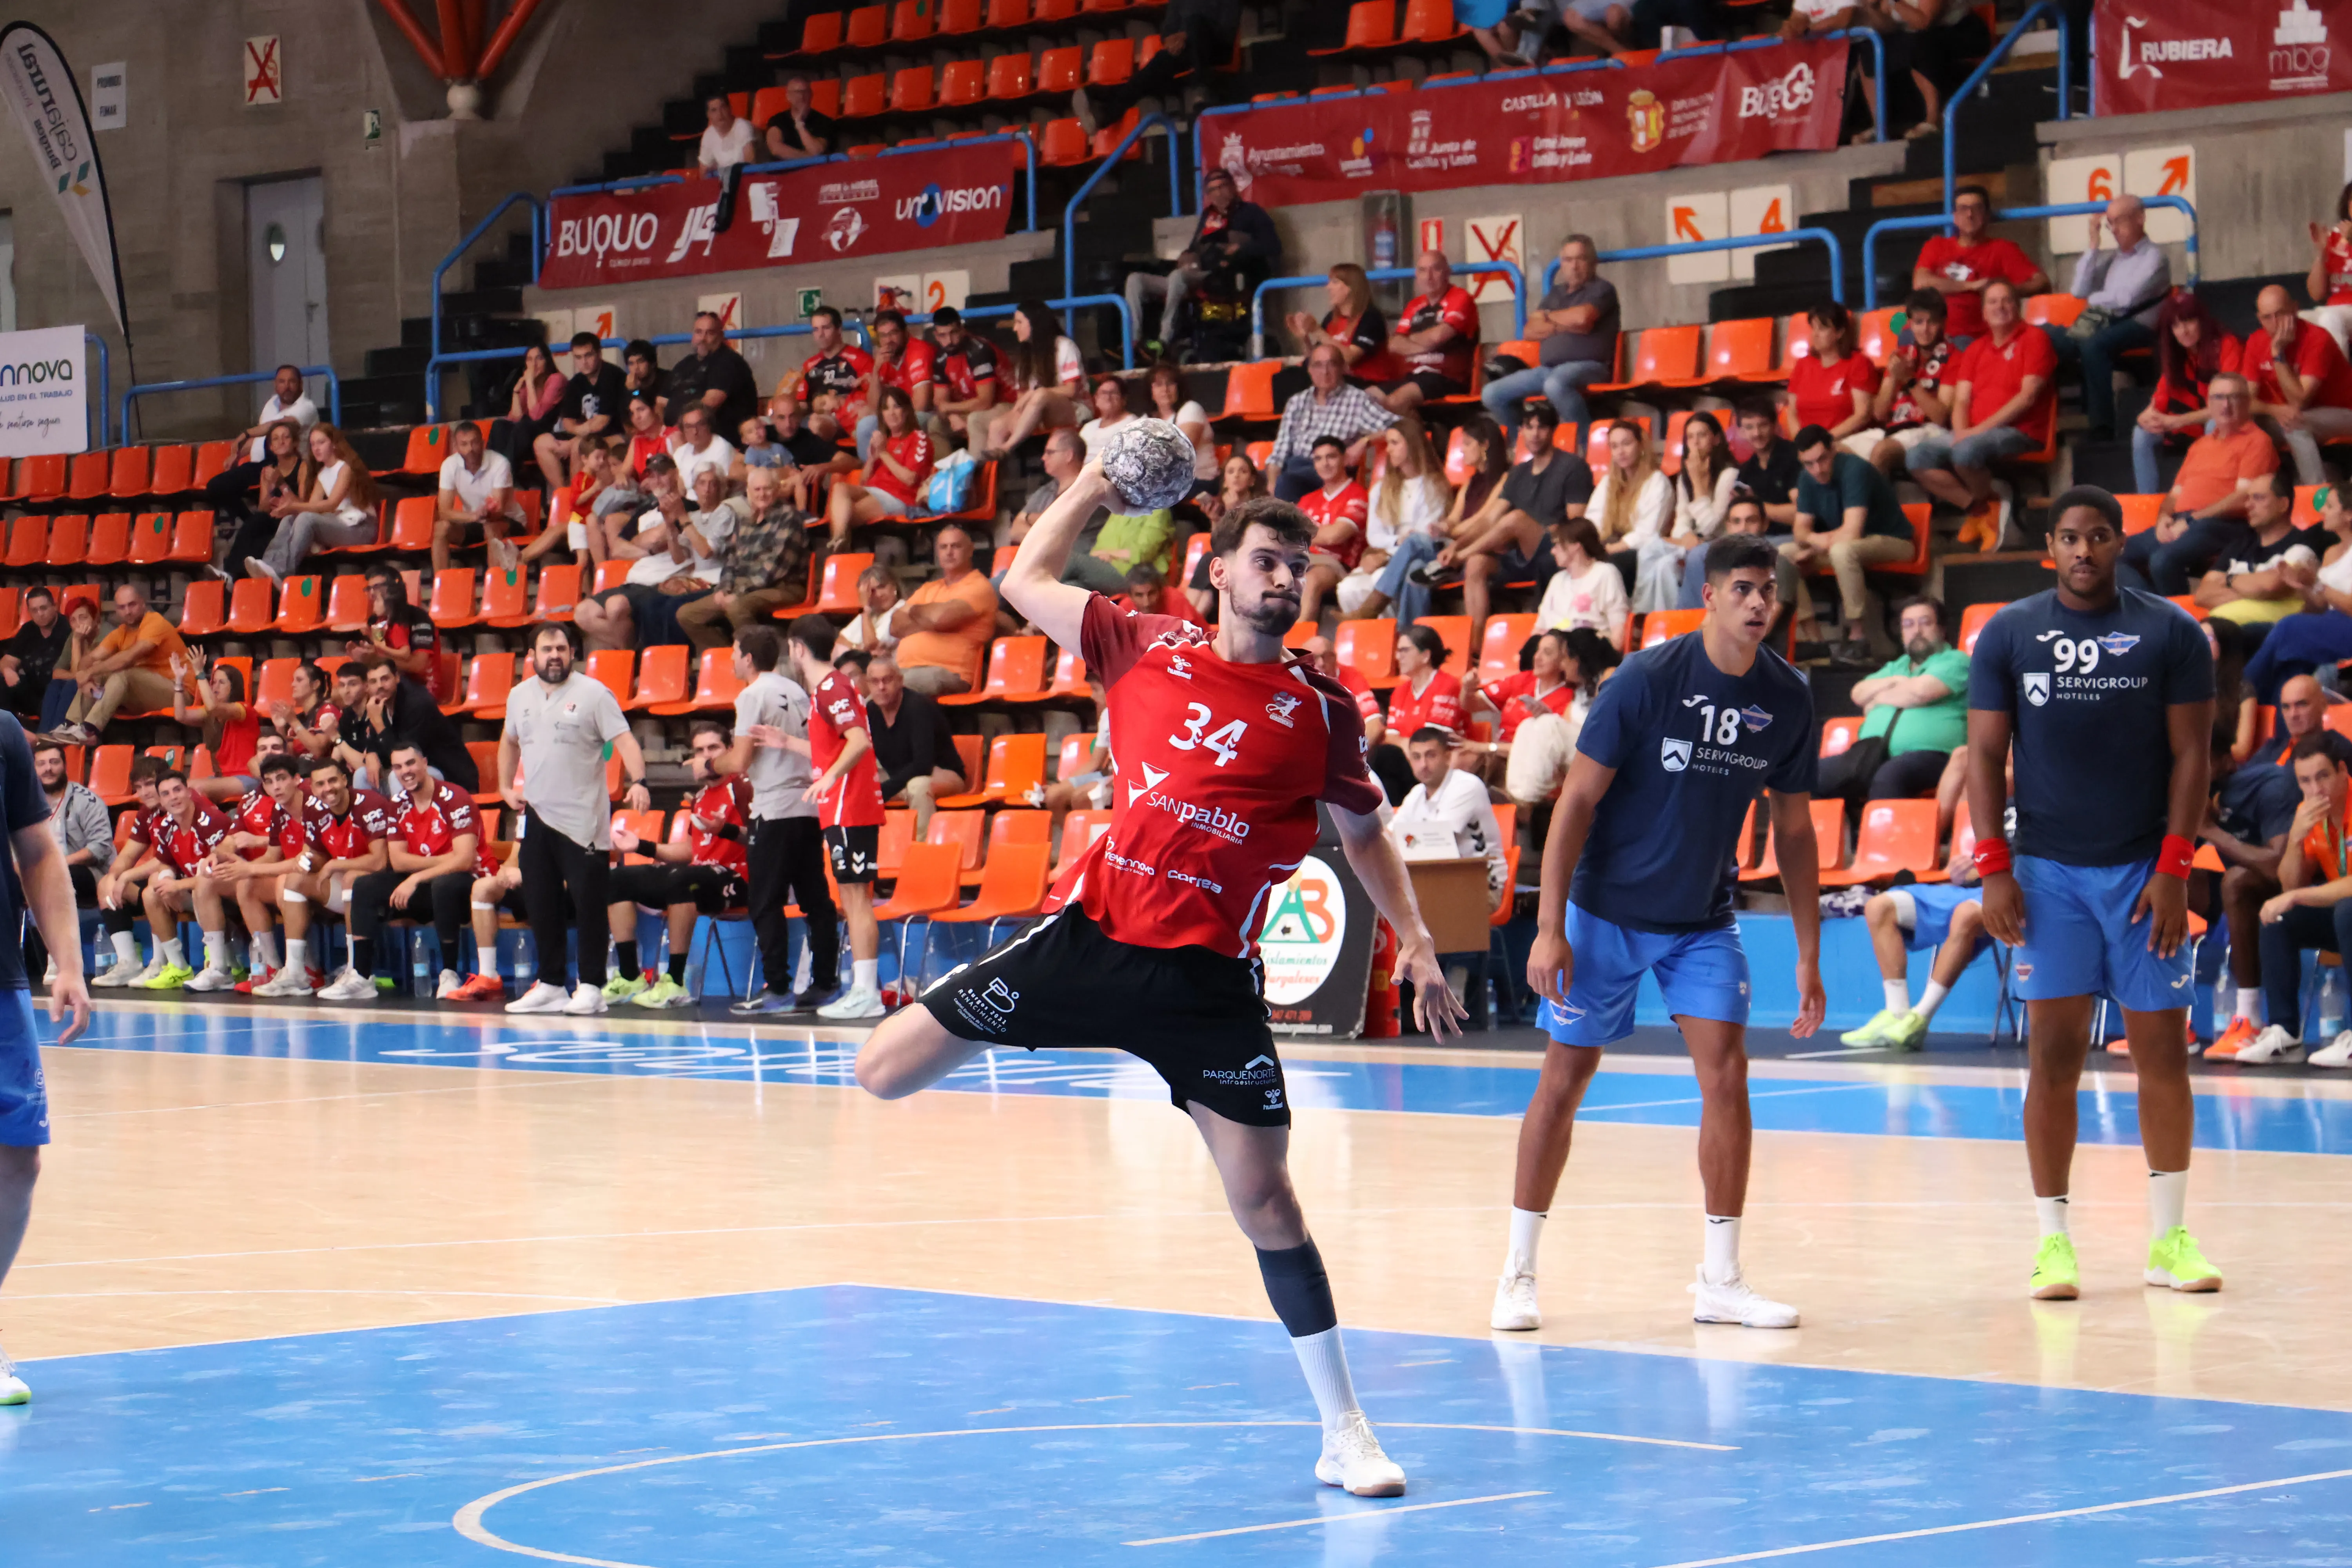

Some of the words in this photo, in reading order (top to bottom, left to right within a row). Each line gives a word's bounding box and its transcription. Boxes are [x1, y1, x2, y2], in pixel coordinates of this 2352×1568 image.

[2141, 37, 2232, 62] RUBIERA
[2269, 46, 2330, 75] mbg
[1501, 93, 1557, 113] CASTILLA
[2088, 168, 2113, 201] 6
[1760, 198, 1785, 233] 4
[557, 212, 658, 268] BUQUO
[928, 280, 945, 313] 2
[40, 390, 73, 399] TRABAJO
[2053, 638, 2099, 675] 99
[1167, 666, 1192, 680] hummel
[2056, 676, 2149, 689] SERVIGROUP
[1169, 702, 1248, 767] 34
[1700, 705, 1740, 746] 18
[1691, 764, 1730, 776] HOTELES
[1696, 747, 1768, 770] SERVIGROUP
[1191, 822, 1243, 846] INMOBILIARIA
[957, 988, 1007, 1033] RENACIMIENTO
[967, 988, 989, 1011] Burgos
[1203, 1067, 1276, 1080] PARQUENORTE
[1263, 1102, 1283, 1110] hummel
